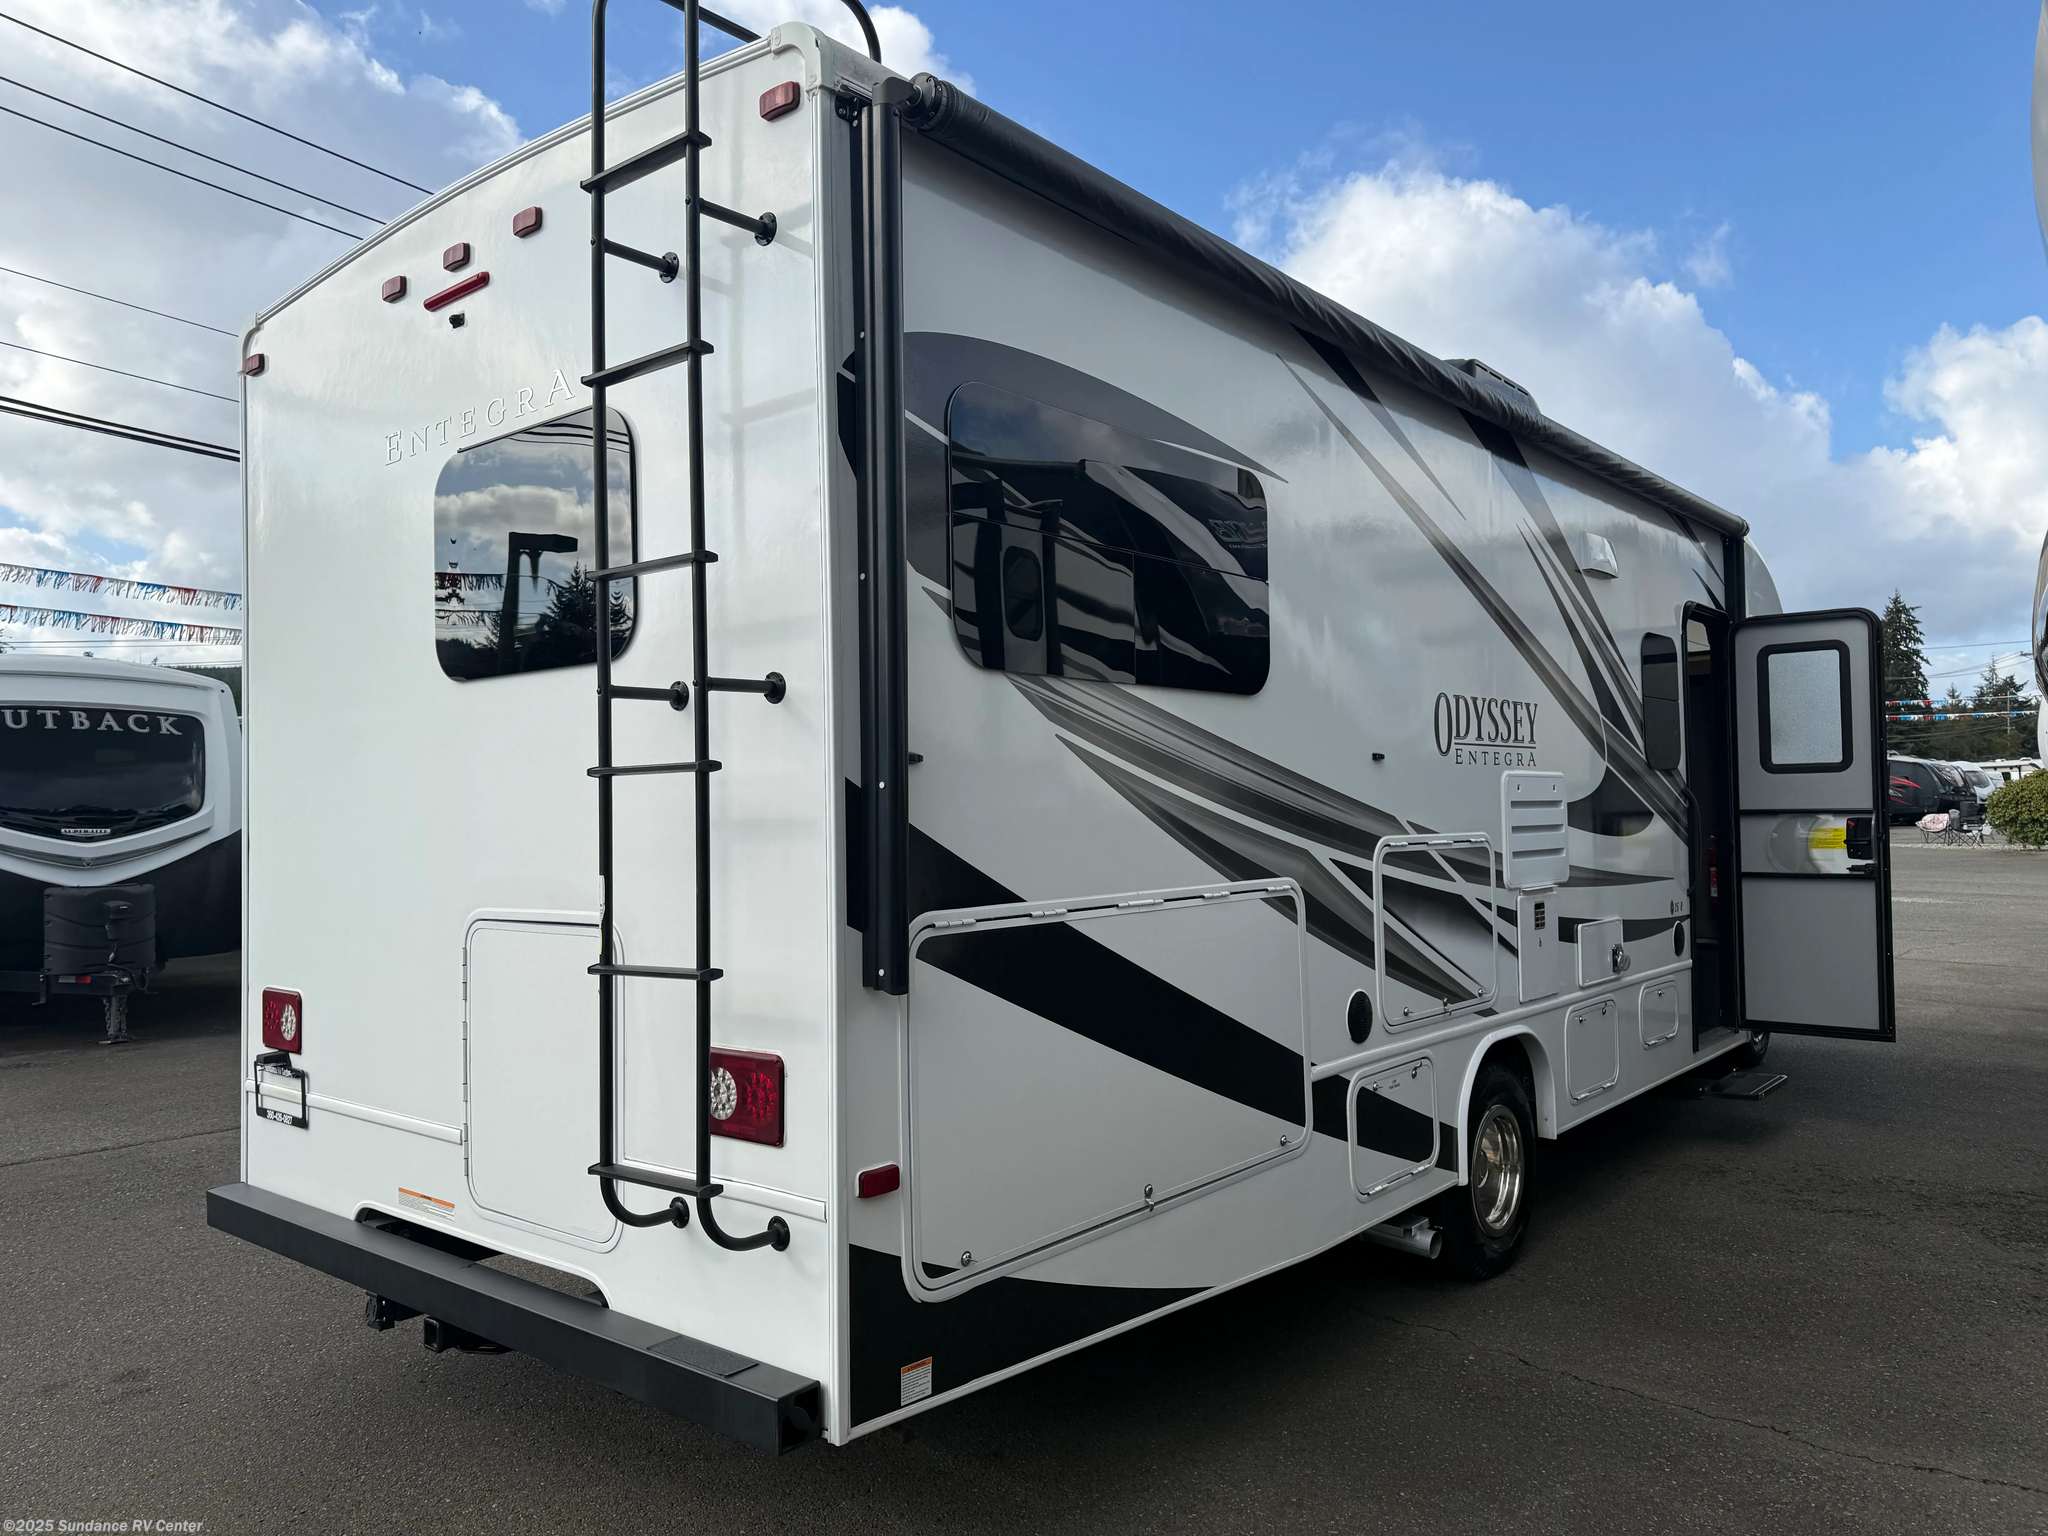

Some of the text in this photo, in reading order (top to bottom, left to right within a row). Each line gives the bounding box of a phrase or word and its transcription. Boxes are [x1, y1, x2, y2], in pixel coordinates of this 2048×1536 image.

[384, 368, 576, 467] ENTEGRA
[1433, 691, 1539, 757] ODYSSEY
[1454, 747, 1537, 767] ENTEGRA
